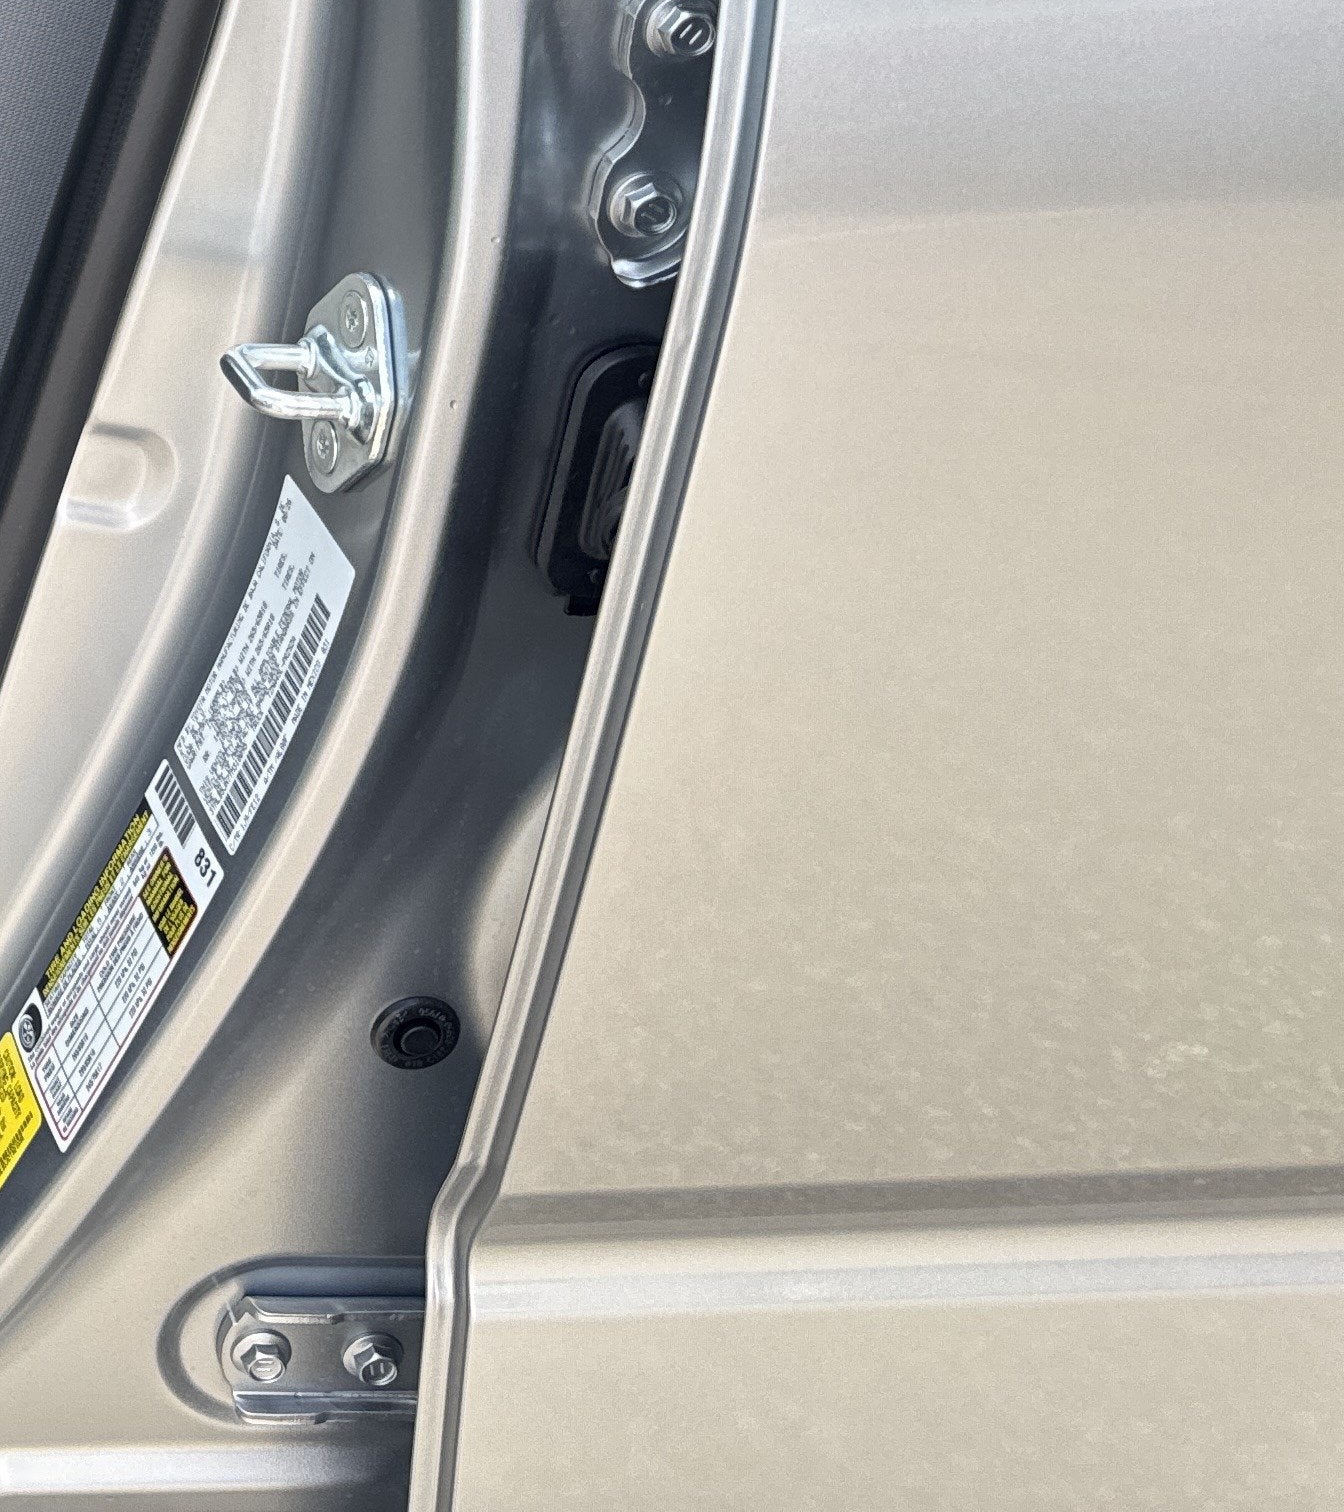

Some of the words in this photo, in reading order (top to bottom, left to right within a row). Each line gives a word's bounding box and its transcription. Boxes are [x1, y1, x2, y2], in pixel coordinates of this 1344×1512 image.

[45, 953, 61, 978] TIRE
[59, 931, 74, 956] AND
[72, 884, 100, 934] LOADING
[98, 812, 141, 887] INFORMATION
[194, 846, 216, 888] 831
